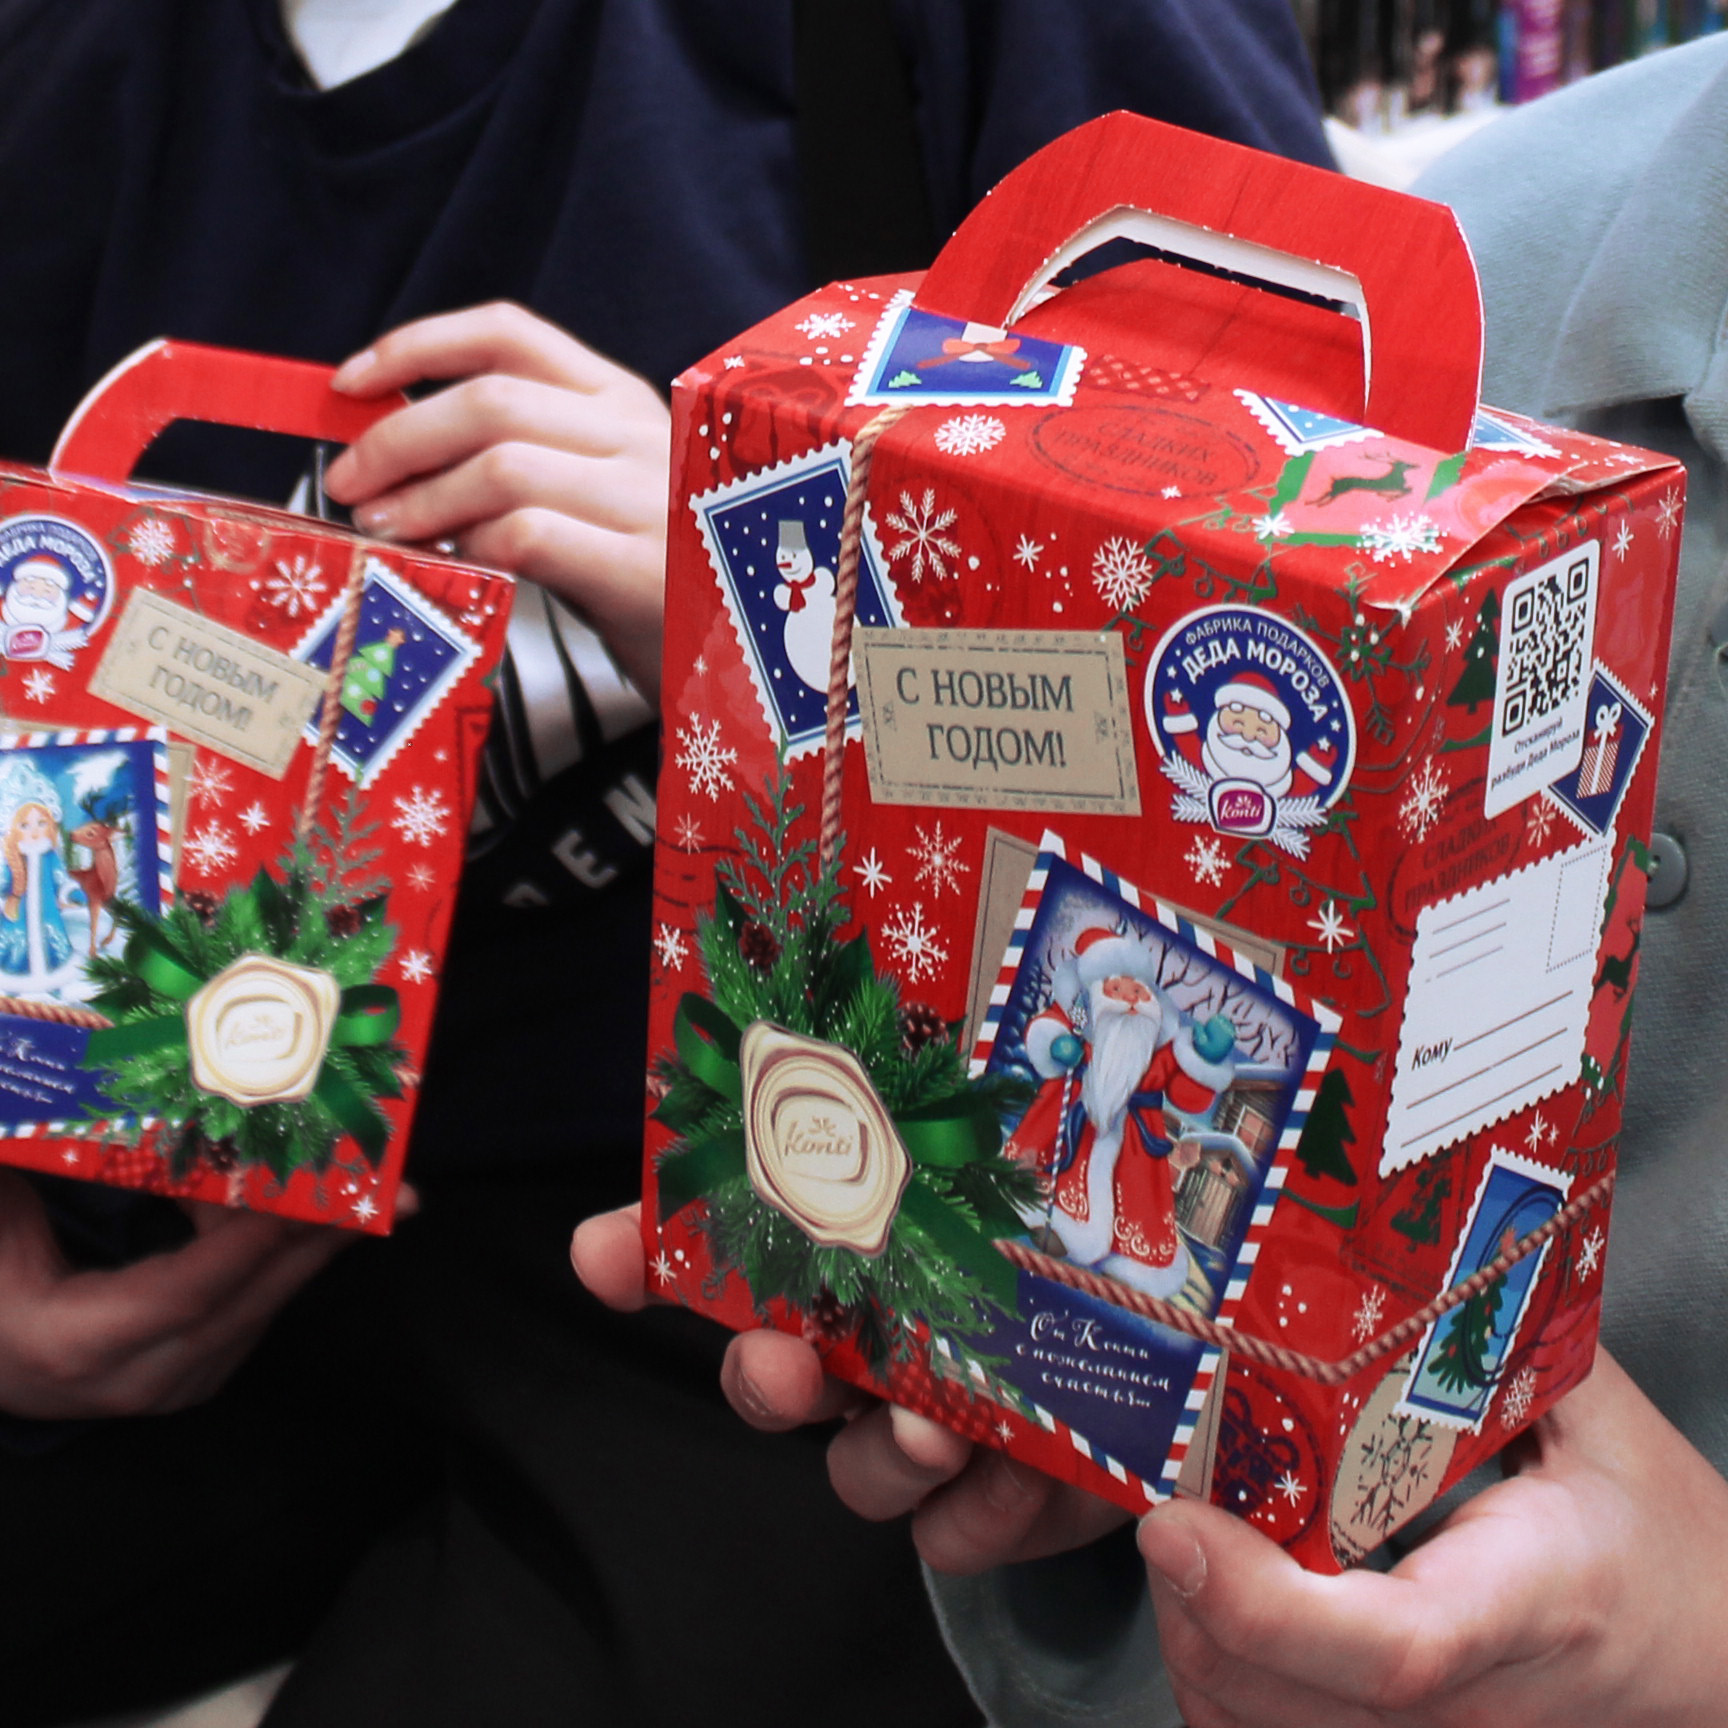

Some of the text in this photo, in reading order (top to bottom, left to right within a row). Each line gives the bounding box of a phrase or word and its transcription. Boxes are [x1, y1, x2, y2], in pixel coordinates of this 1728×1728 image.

[38, 534, 96, 585] МОРОЗА
[147, 626, 280, 705] С НОВЫМ
[1184, 617, 1331, 689] ФАБРИКА ПОДАРКОВ
[149, 664, 254, 733] ГОДОМ!
[896, 667, 1075, 713] С НОВЫМ
[1181, 637, 1329, 723] ДЕДА МОРОЗА
[926, 722, 1068, 772] ГОДОМ!
[1411, 1037, 1453, 1071] Кому
[1029, 1310, 1150, 1360] От Конти
